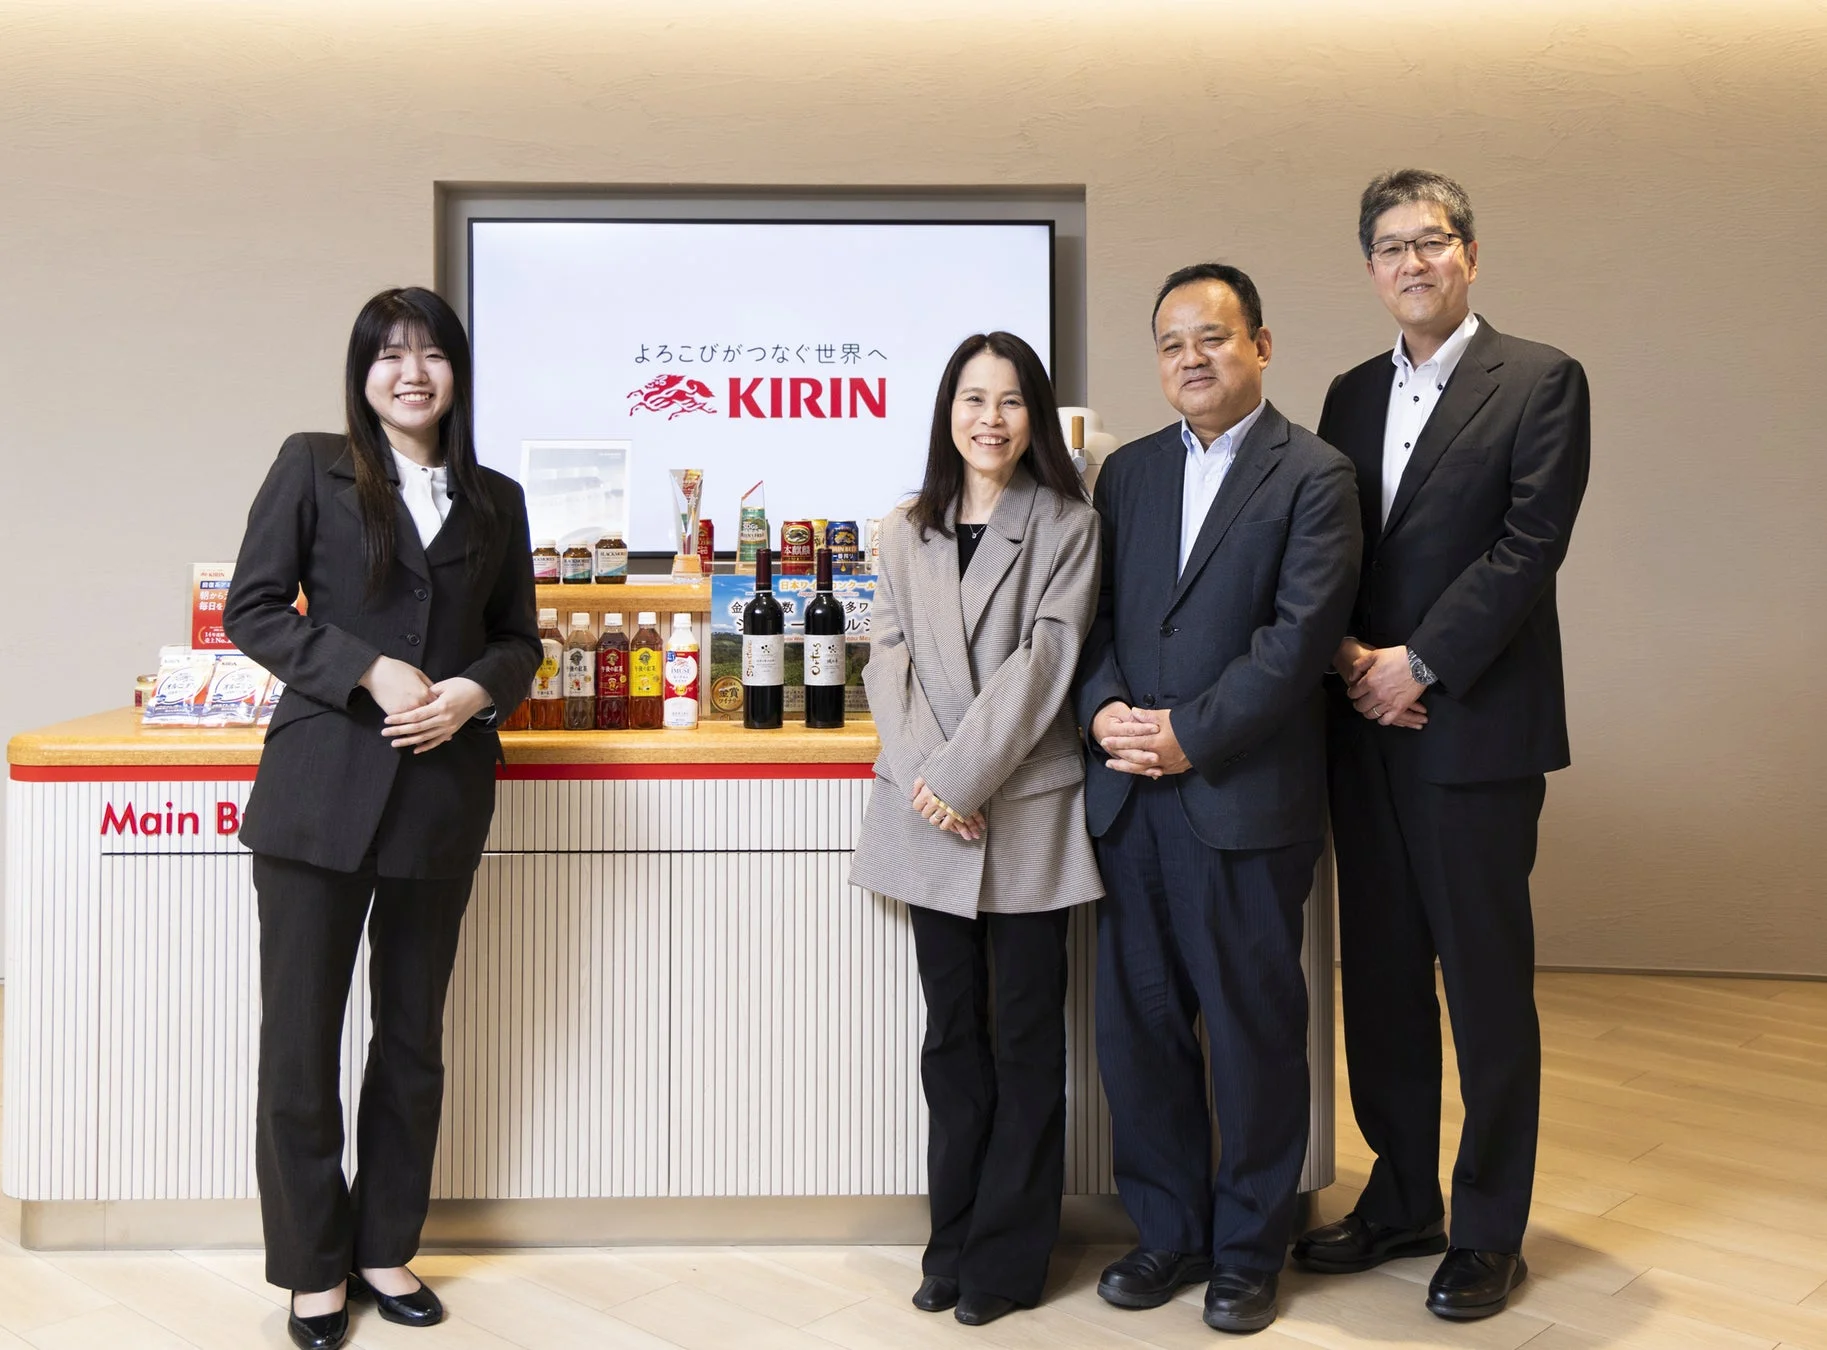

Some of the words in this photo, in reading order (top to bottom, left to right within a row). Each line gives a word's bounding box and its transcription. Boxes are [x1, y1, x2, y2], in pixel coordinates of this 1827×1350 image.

[634, 343, 887, 365] よろこびがつなぐ世界へ
[728, 377, 886, 418] KIRIN
[780, 580, 877, 590] 日本ワイコンクール
[100, 801, 200, 835] Main
[216, 801, 245, 835] B
